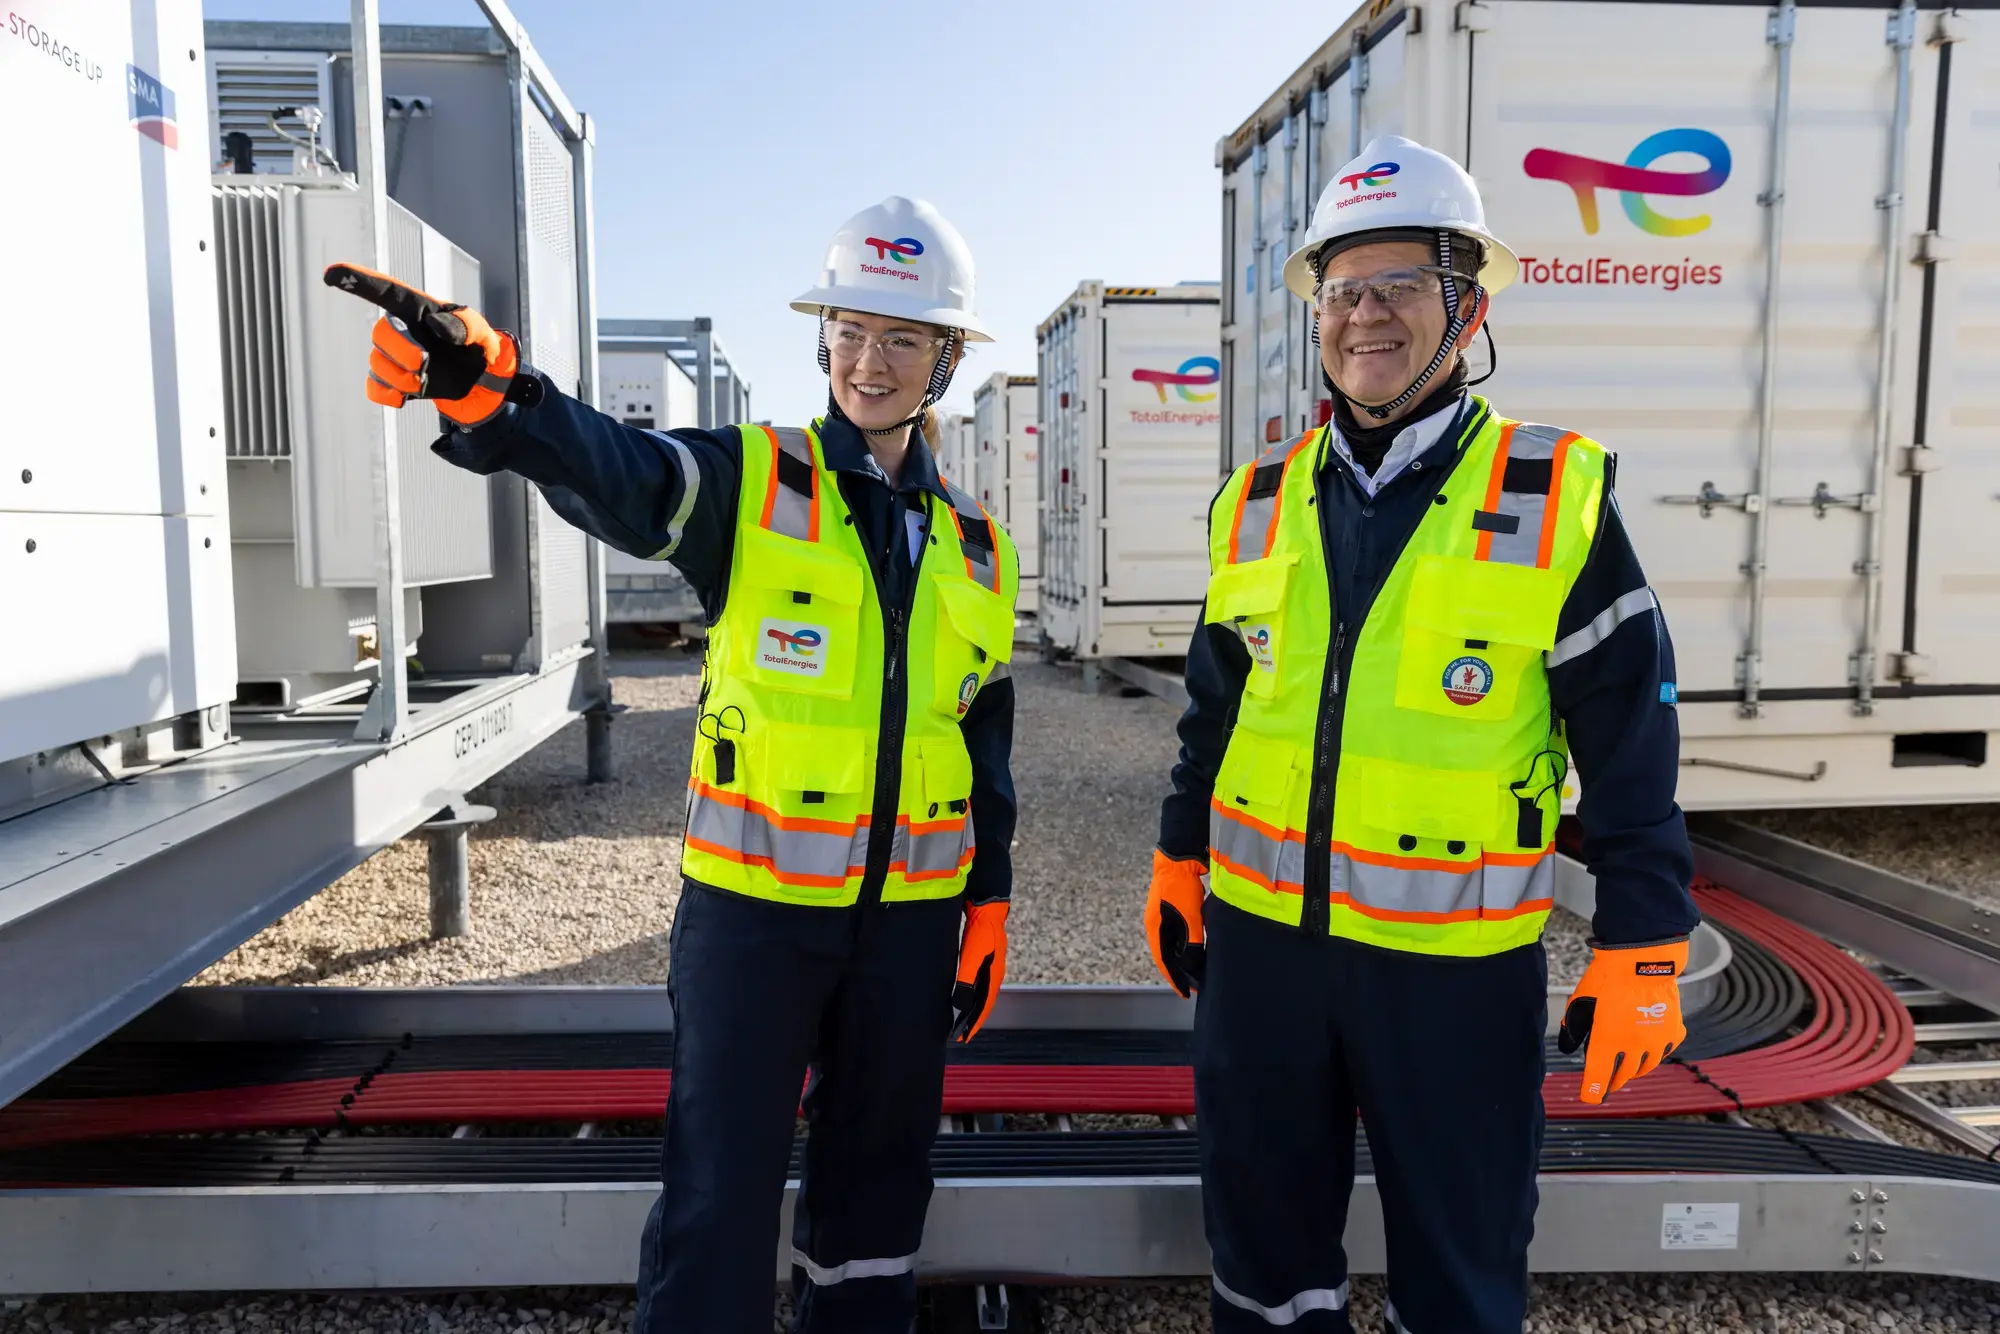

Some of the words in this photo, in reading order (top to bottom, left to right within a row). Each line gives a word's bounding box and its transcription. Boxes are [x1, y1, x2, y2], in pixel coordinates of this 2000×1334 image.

[9, 12, 81, 73] STORAGE
[85, 57, 103, 84] UP
[129, 72, 160, 108] SMA
[1336, 191, 1397, 210] TotalEnergies
[860, 264, 919, 281] TotalEnergies
[1518, 258, 1722, 291] TotalEnergies
[763, 653, 818, 669] TotalEnergies
